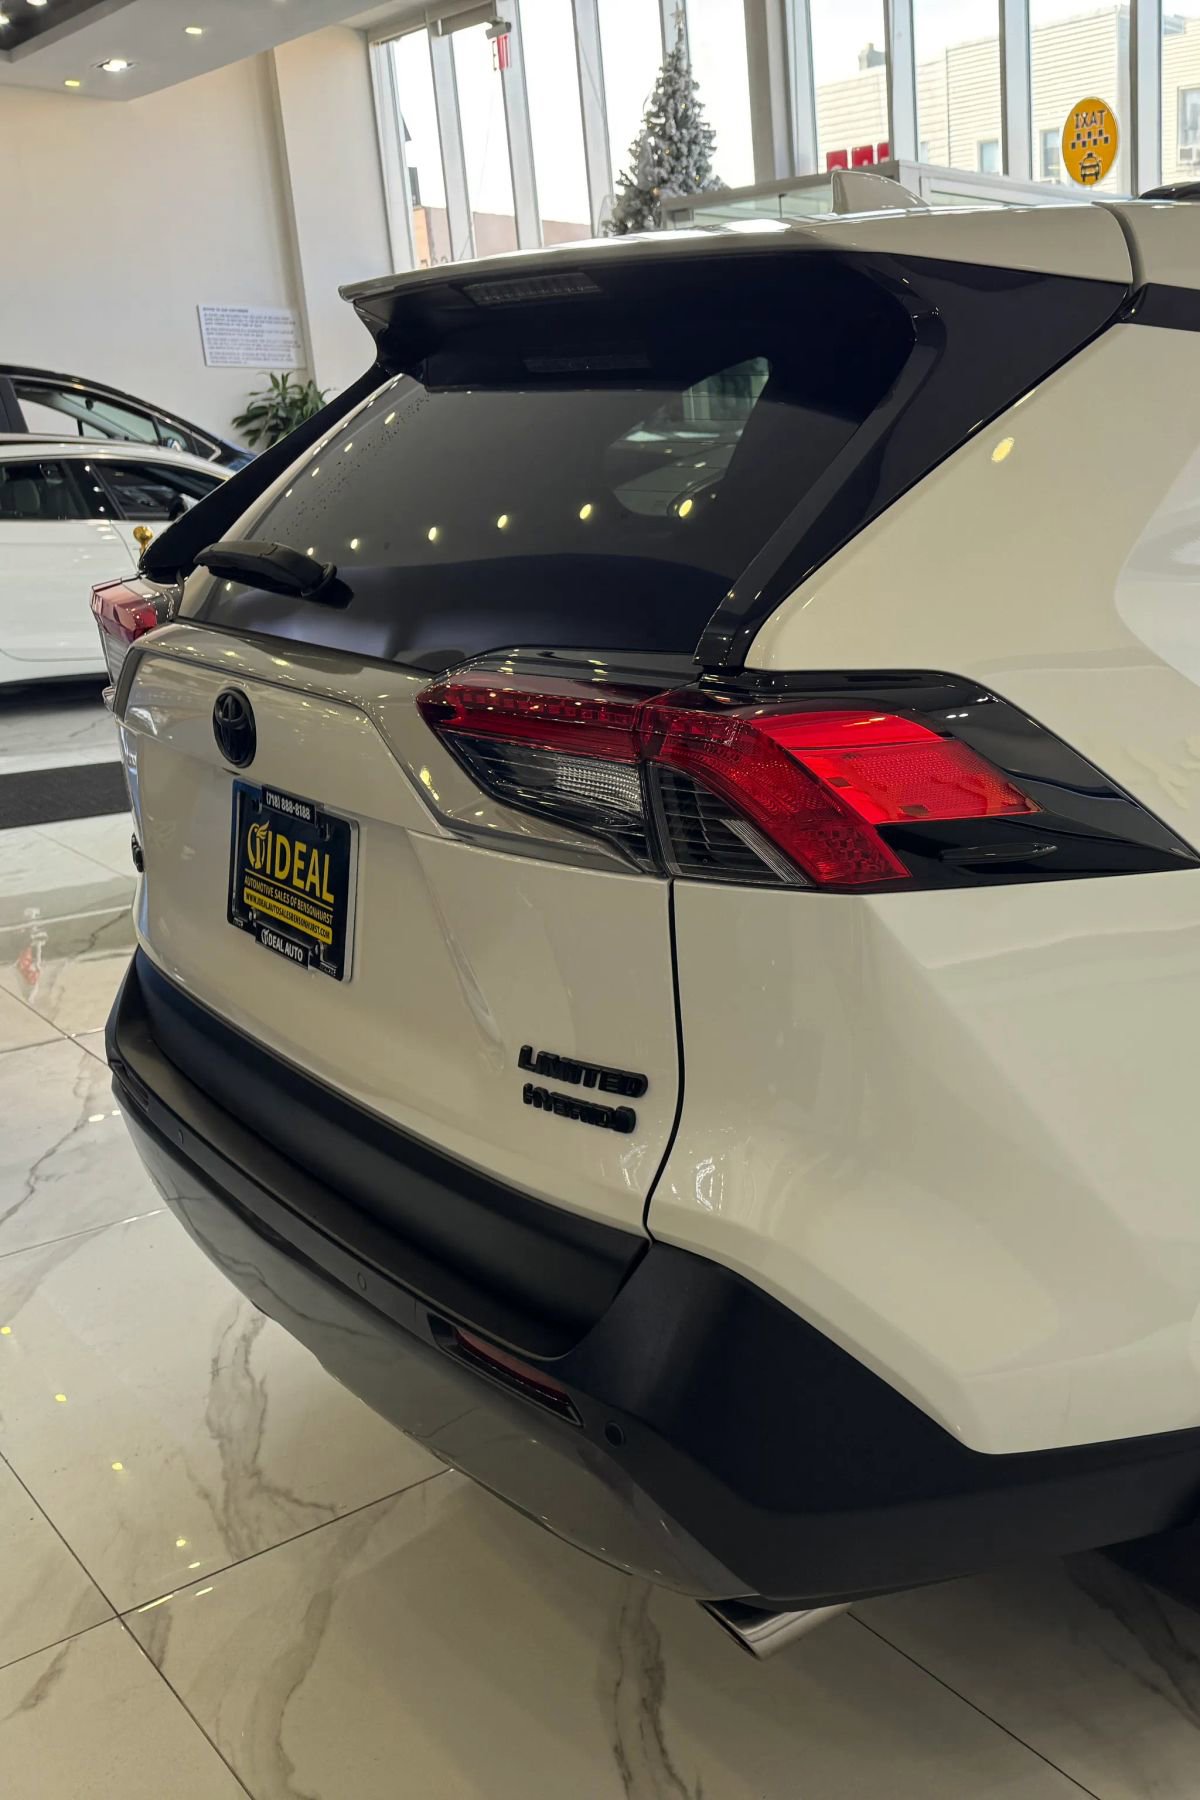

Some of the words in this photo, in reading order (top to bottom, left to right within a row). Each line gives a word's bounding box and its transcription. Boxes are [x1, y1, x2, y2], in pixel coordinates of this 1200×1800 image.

[265, 791, 281, 808] (718)
[280, 797, 311, 821] 888-8188
[265, 830, 335, 904] IDEAL
[244, 875, 274, 898] AUTOMOTIVE
[274, 888, 290, 905] SALES
[289, 896, 297, 907] OF
[297, 898, 334, 925] BENSONHURST
[284, 944, 304, 962] AUTO
[517, 1044, 649, 1099] LIMITED
